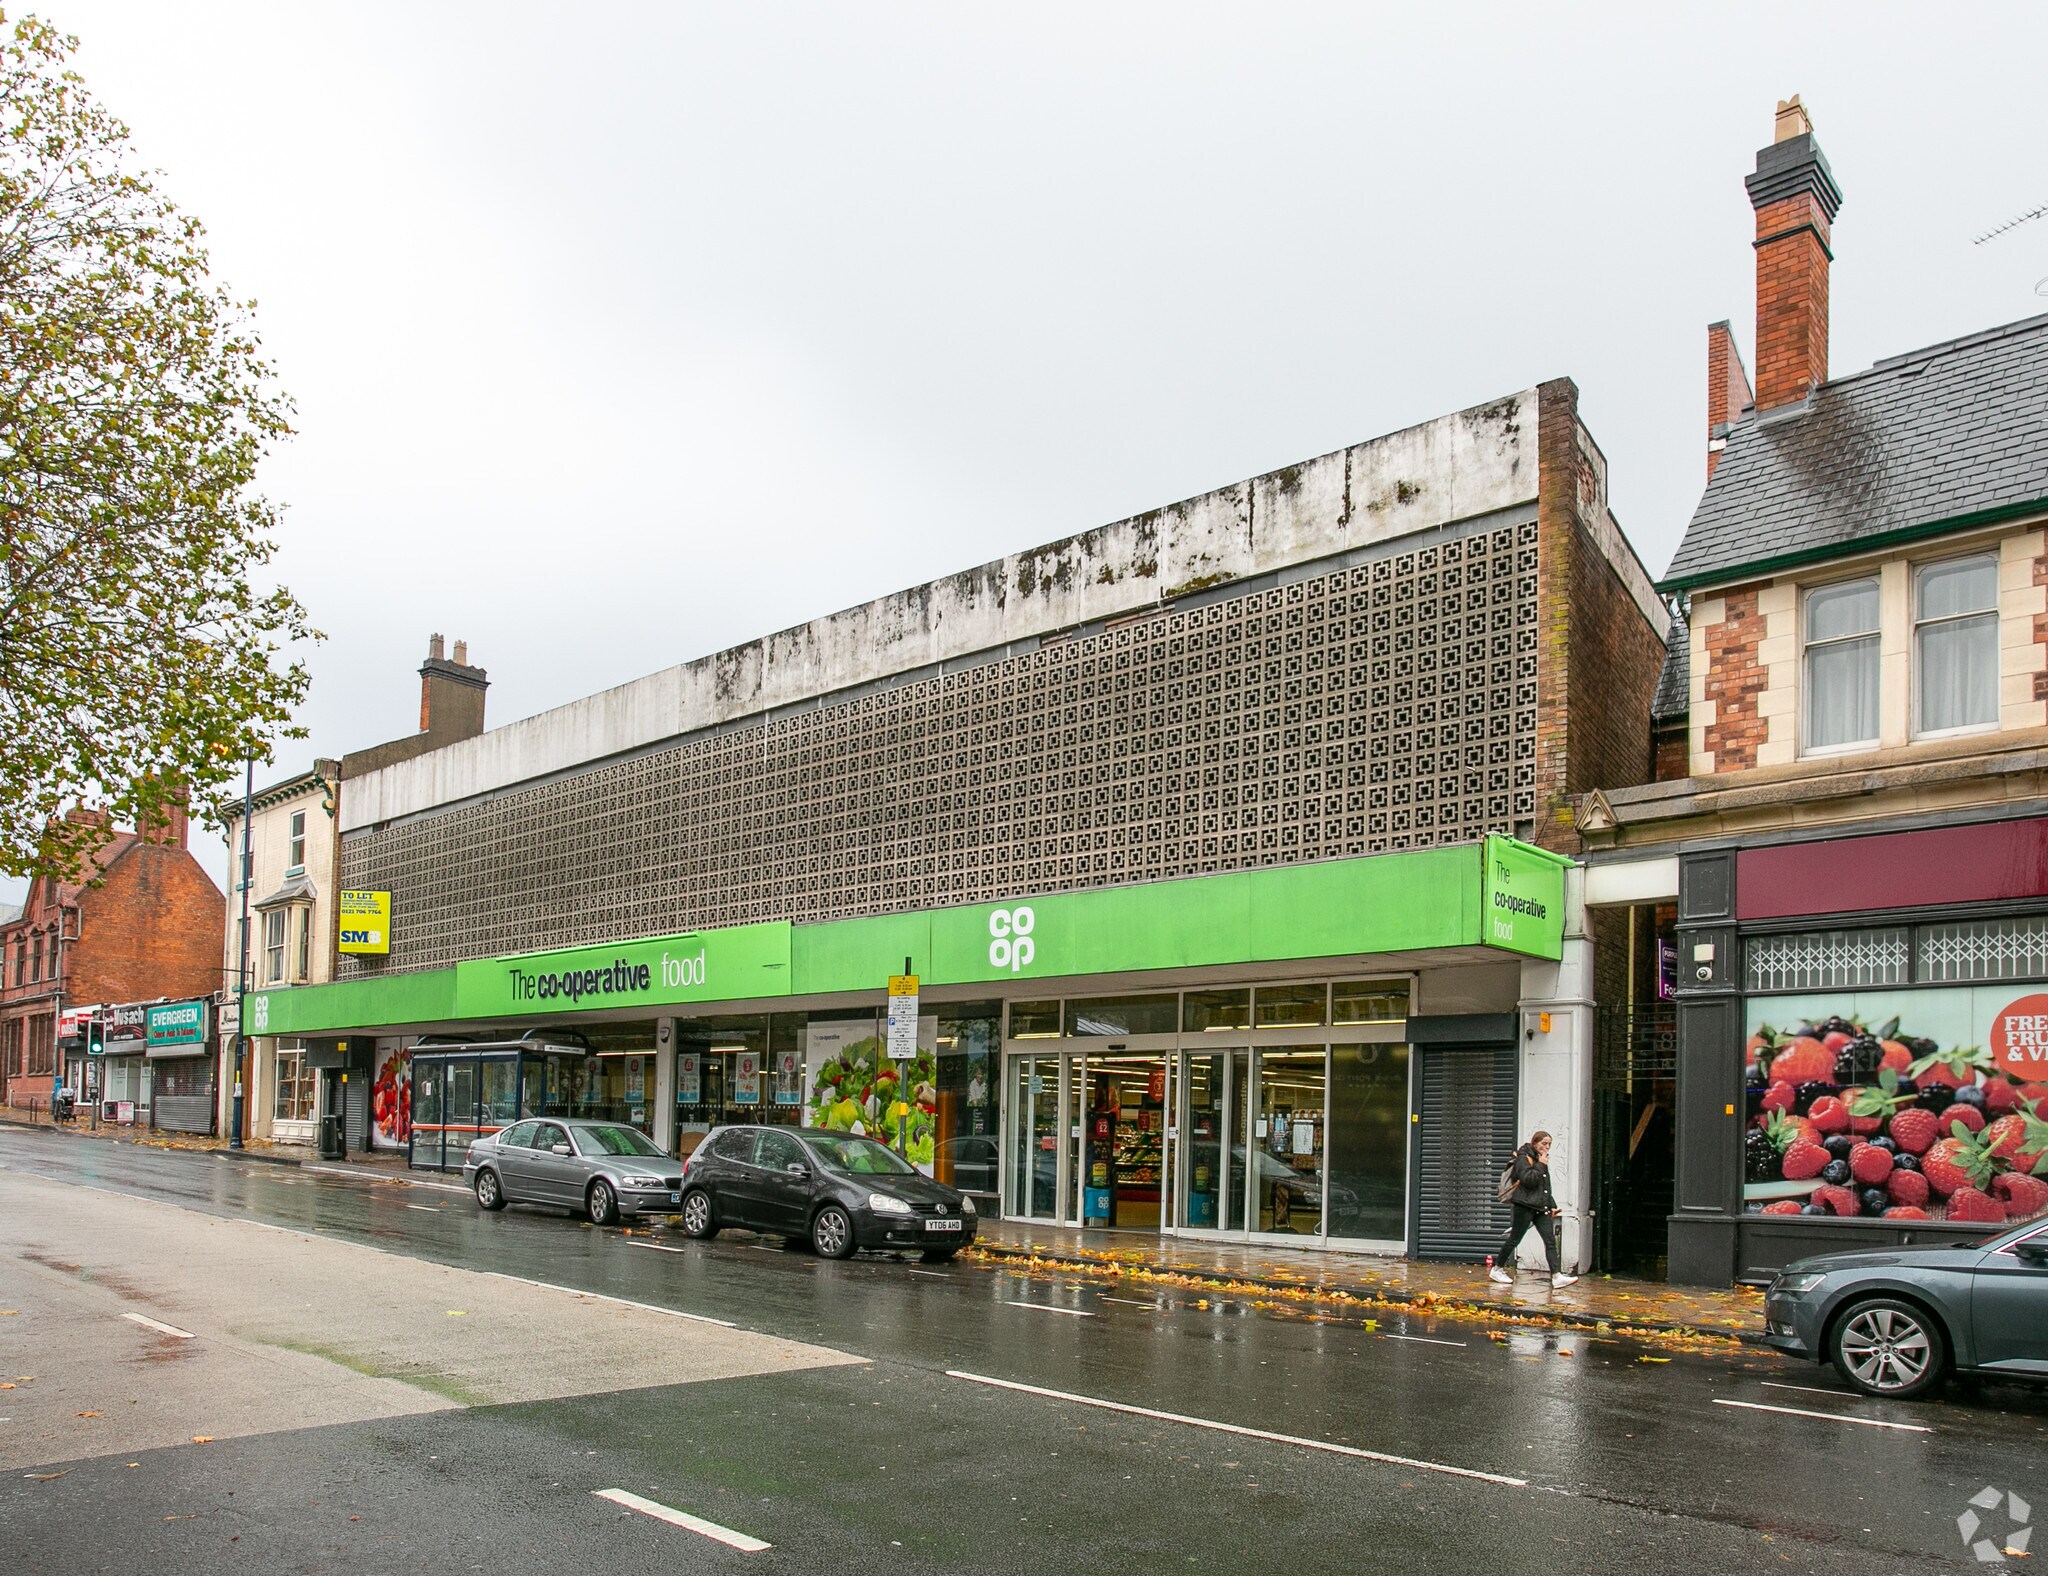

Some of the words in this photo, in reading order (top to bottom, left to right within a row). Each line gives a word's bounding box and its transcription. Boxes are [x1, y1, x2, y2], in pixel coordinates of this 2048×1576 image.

[1496, 860, 1510, 884] The
[1495, 891, 1546, 919] co-operative
[1494, 917, 1513, 940] food
[509, 969, 536, 1000] The
[537, 959, 651, 1003] co-operative
[661, 948, 705, 987] food
[152, 1008, 198, 1027] EVERGREEN
[2007, 1046, 2023, 1062] &
[2027, 1046, 2048, 1061] V
[929, 1221, 947, 1229] YT06
